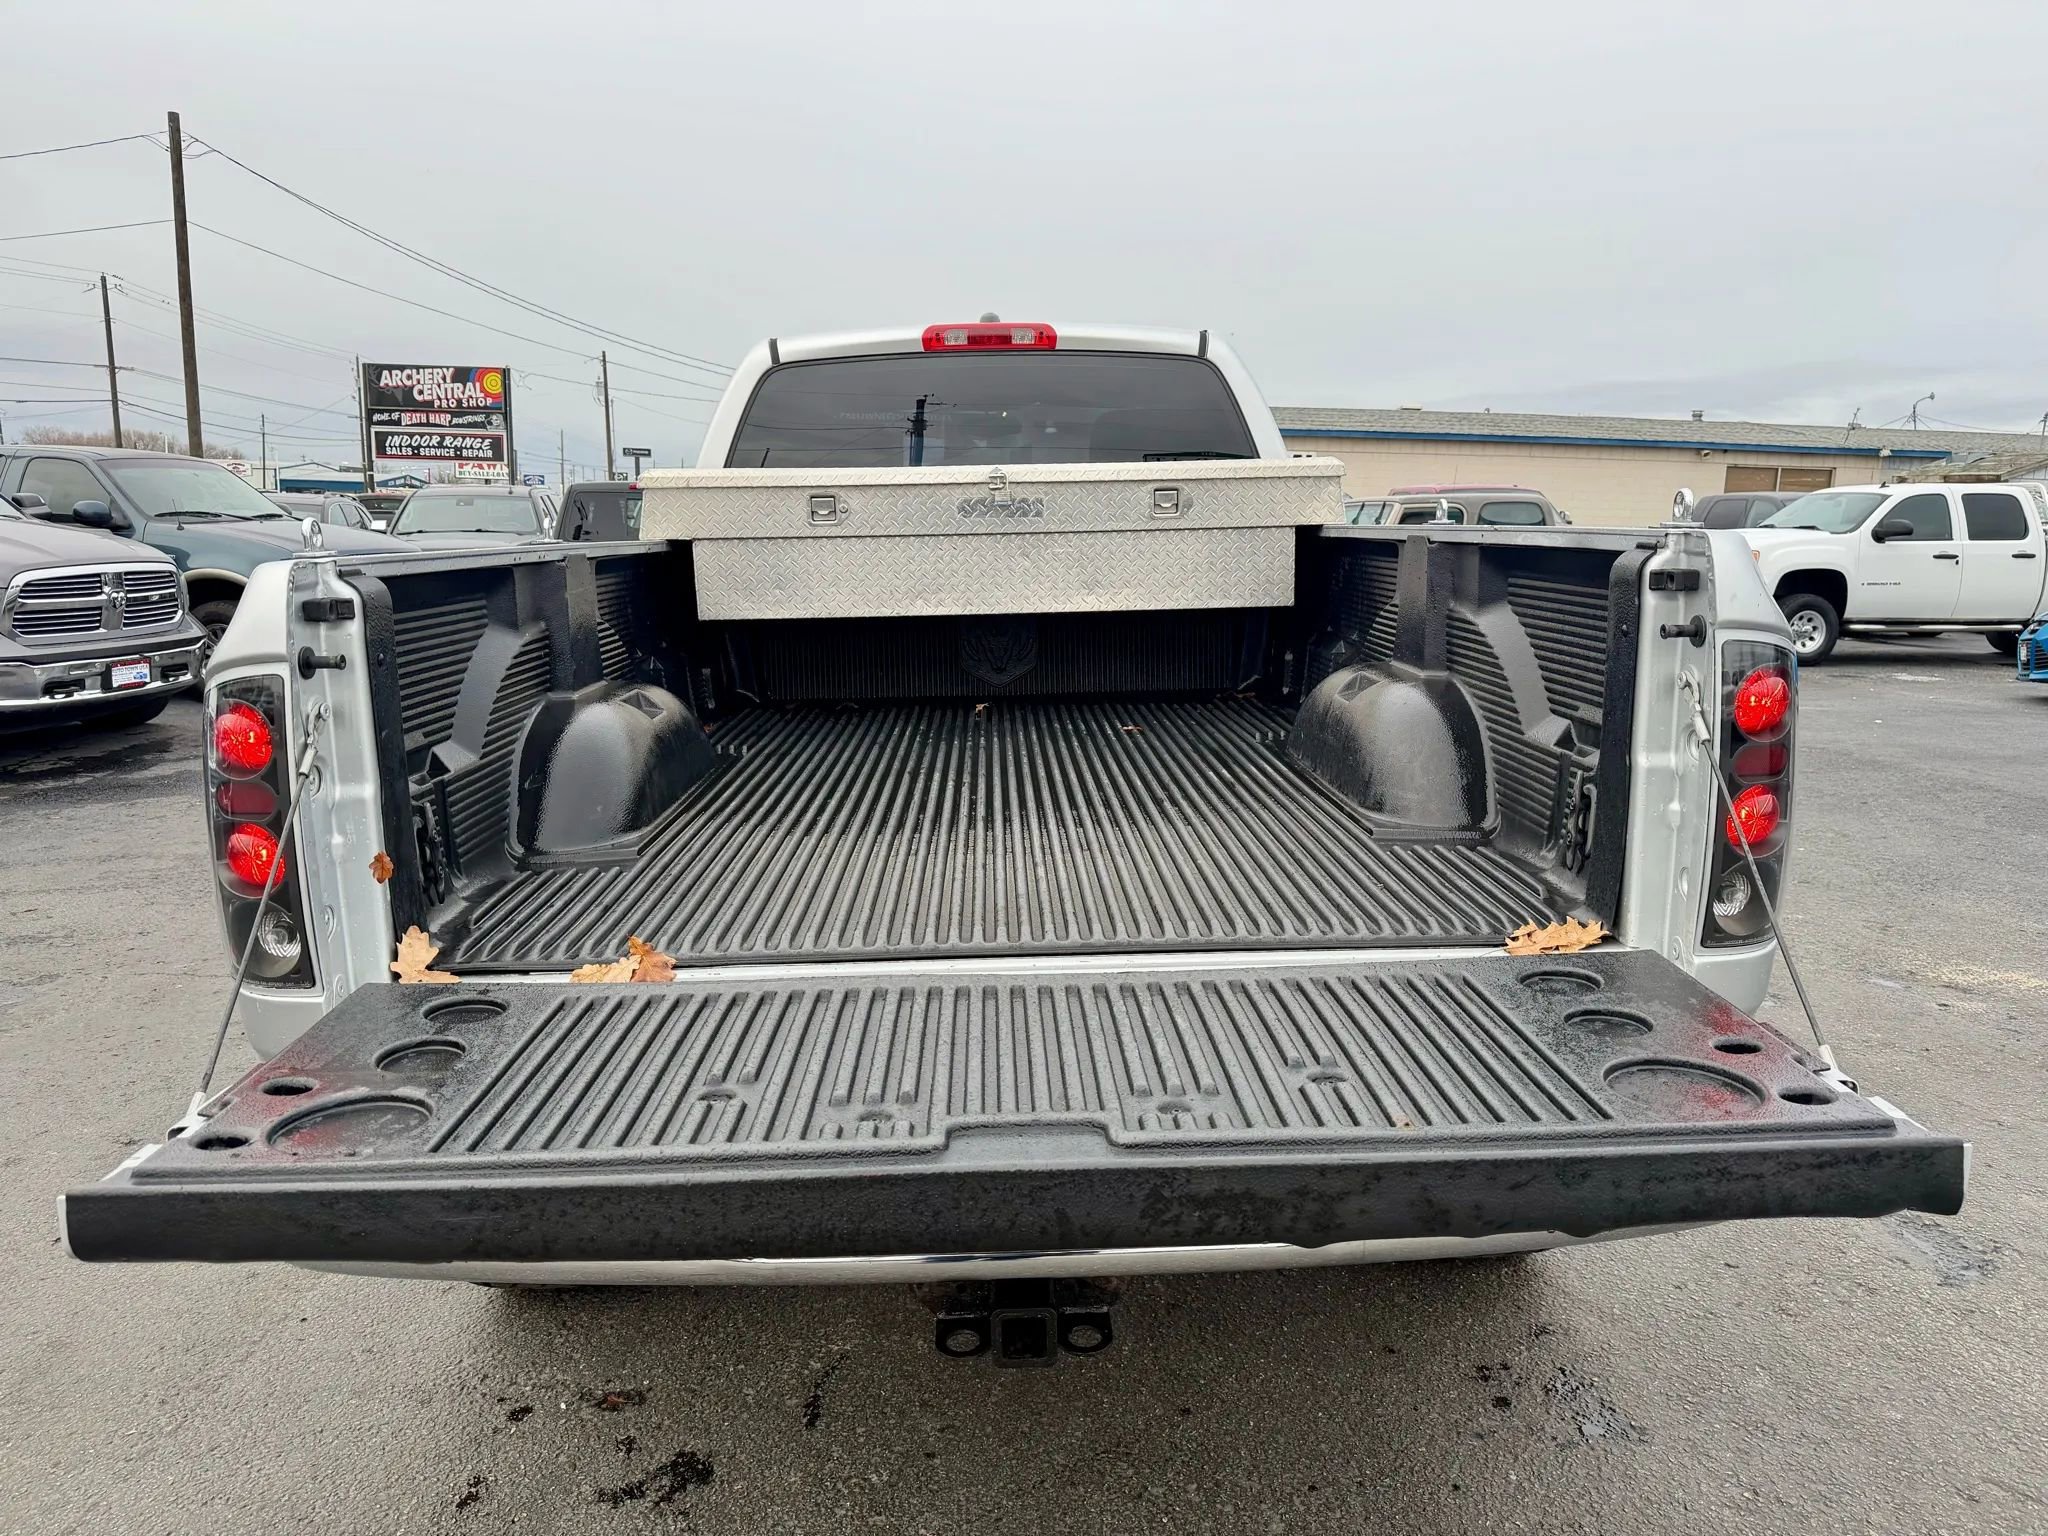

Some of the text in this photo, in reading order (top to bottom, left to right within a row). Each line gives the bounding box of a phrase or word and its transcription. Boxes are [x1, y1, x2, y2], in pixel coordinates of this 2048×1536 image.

[379, 368, 455, 387] ARCHERY
[413, 382, 485, 401] CENTRAL
[434, 397, 493, 408] PRO SHOP
[372, 413, 391, 422] HOME
[391, 412, 401, 421] OF
[401, 412, 427, 426] DEATH
[385, 434, 493, 450] INDOOR RANGE
[386, 447, 493, 458] SALES SERVICE REPAIR
